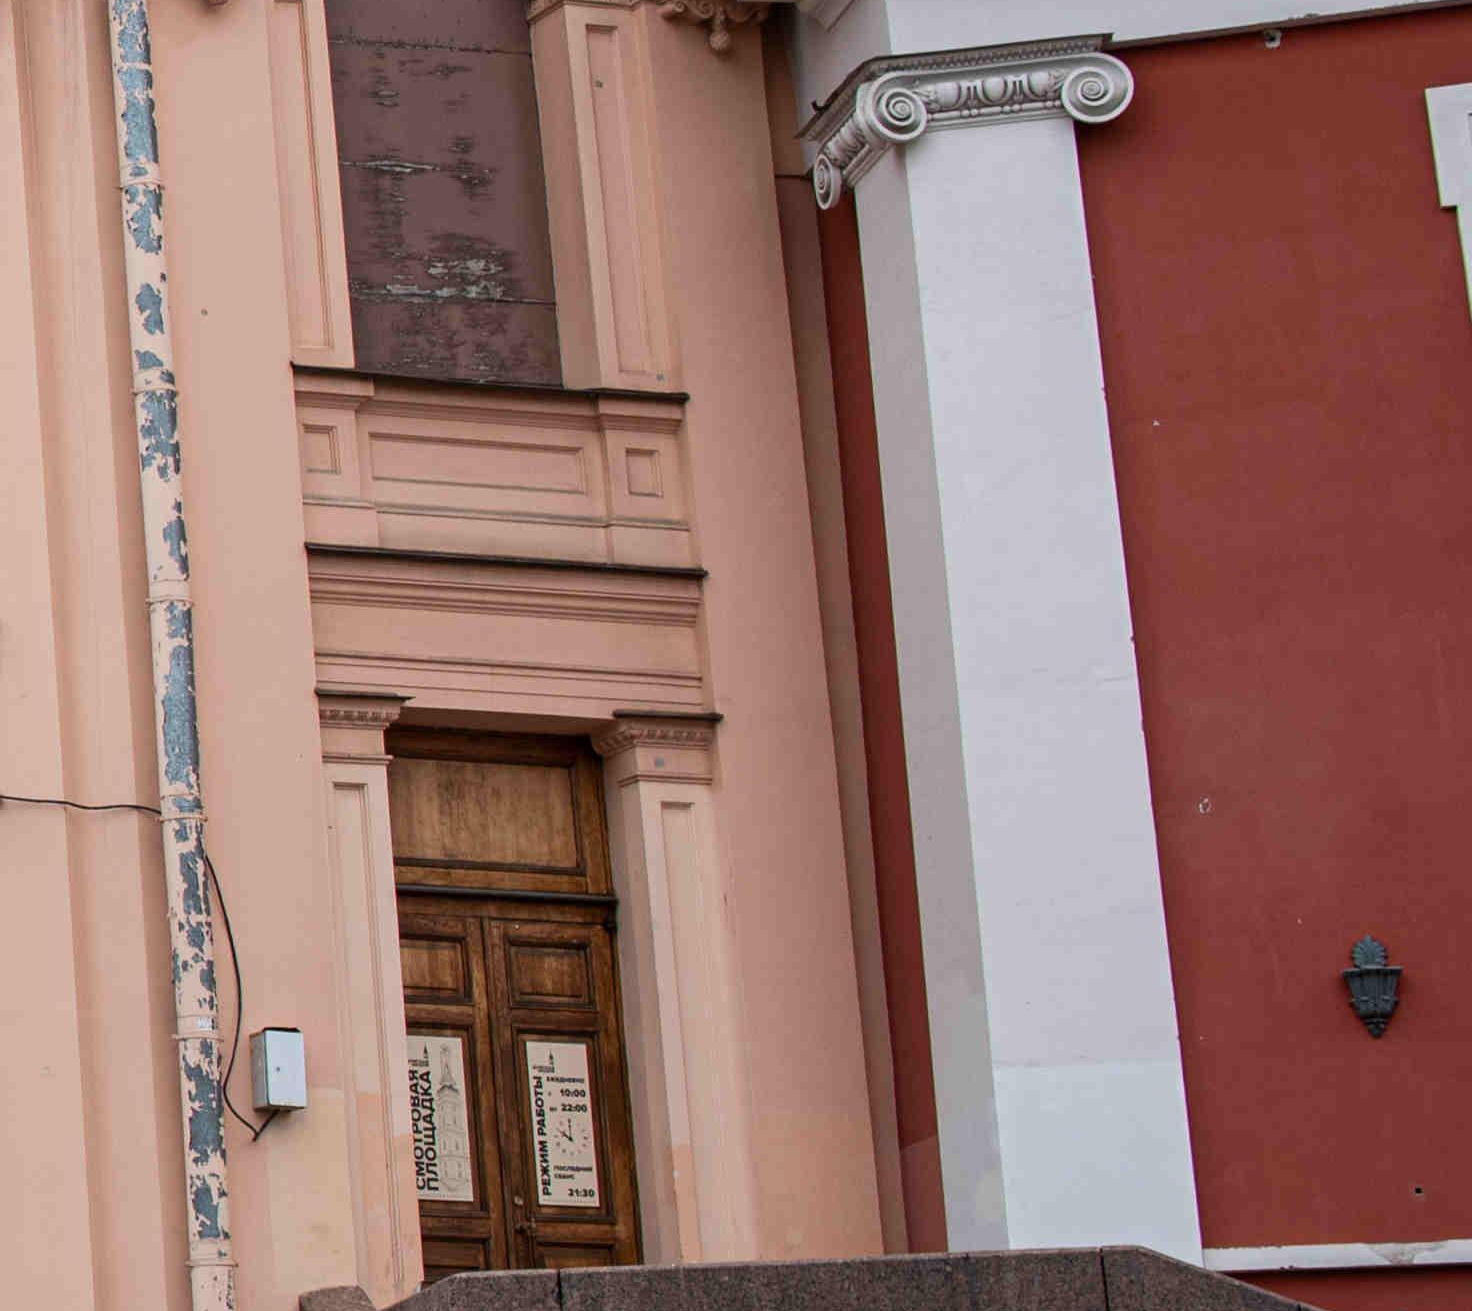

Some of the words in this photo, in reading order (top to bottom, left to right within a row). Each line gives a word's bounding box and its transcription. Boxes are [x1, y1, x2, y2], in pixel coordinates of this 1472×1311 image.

[533, 1076, 547, 1136] РАБОТЫ
[560, 1088, 586, 1098] 10:00
[561, 1103, 588, 1113] 22:00
[408, 1070, 426, 1190] СМОТРОВАЯ
[419, 1071, 439, 1190] ПЛОЩАДКА
[537, 1140, 552, 1196] РЕЖИМ
[568, 1188, 595, 1198] 21:30
